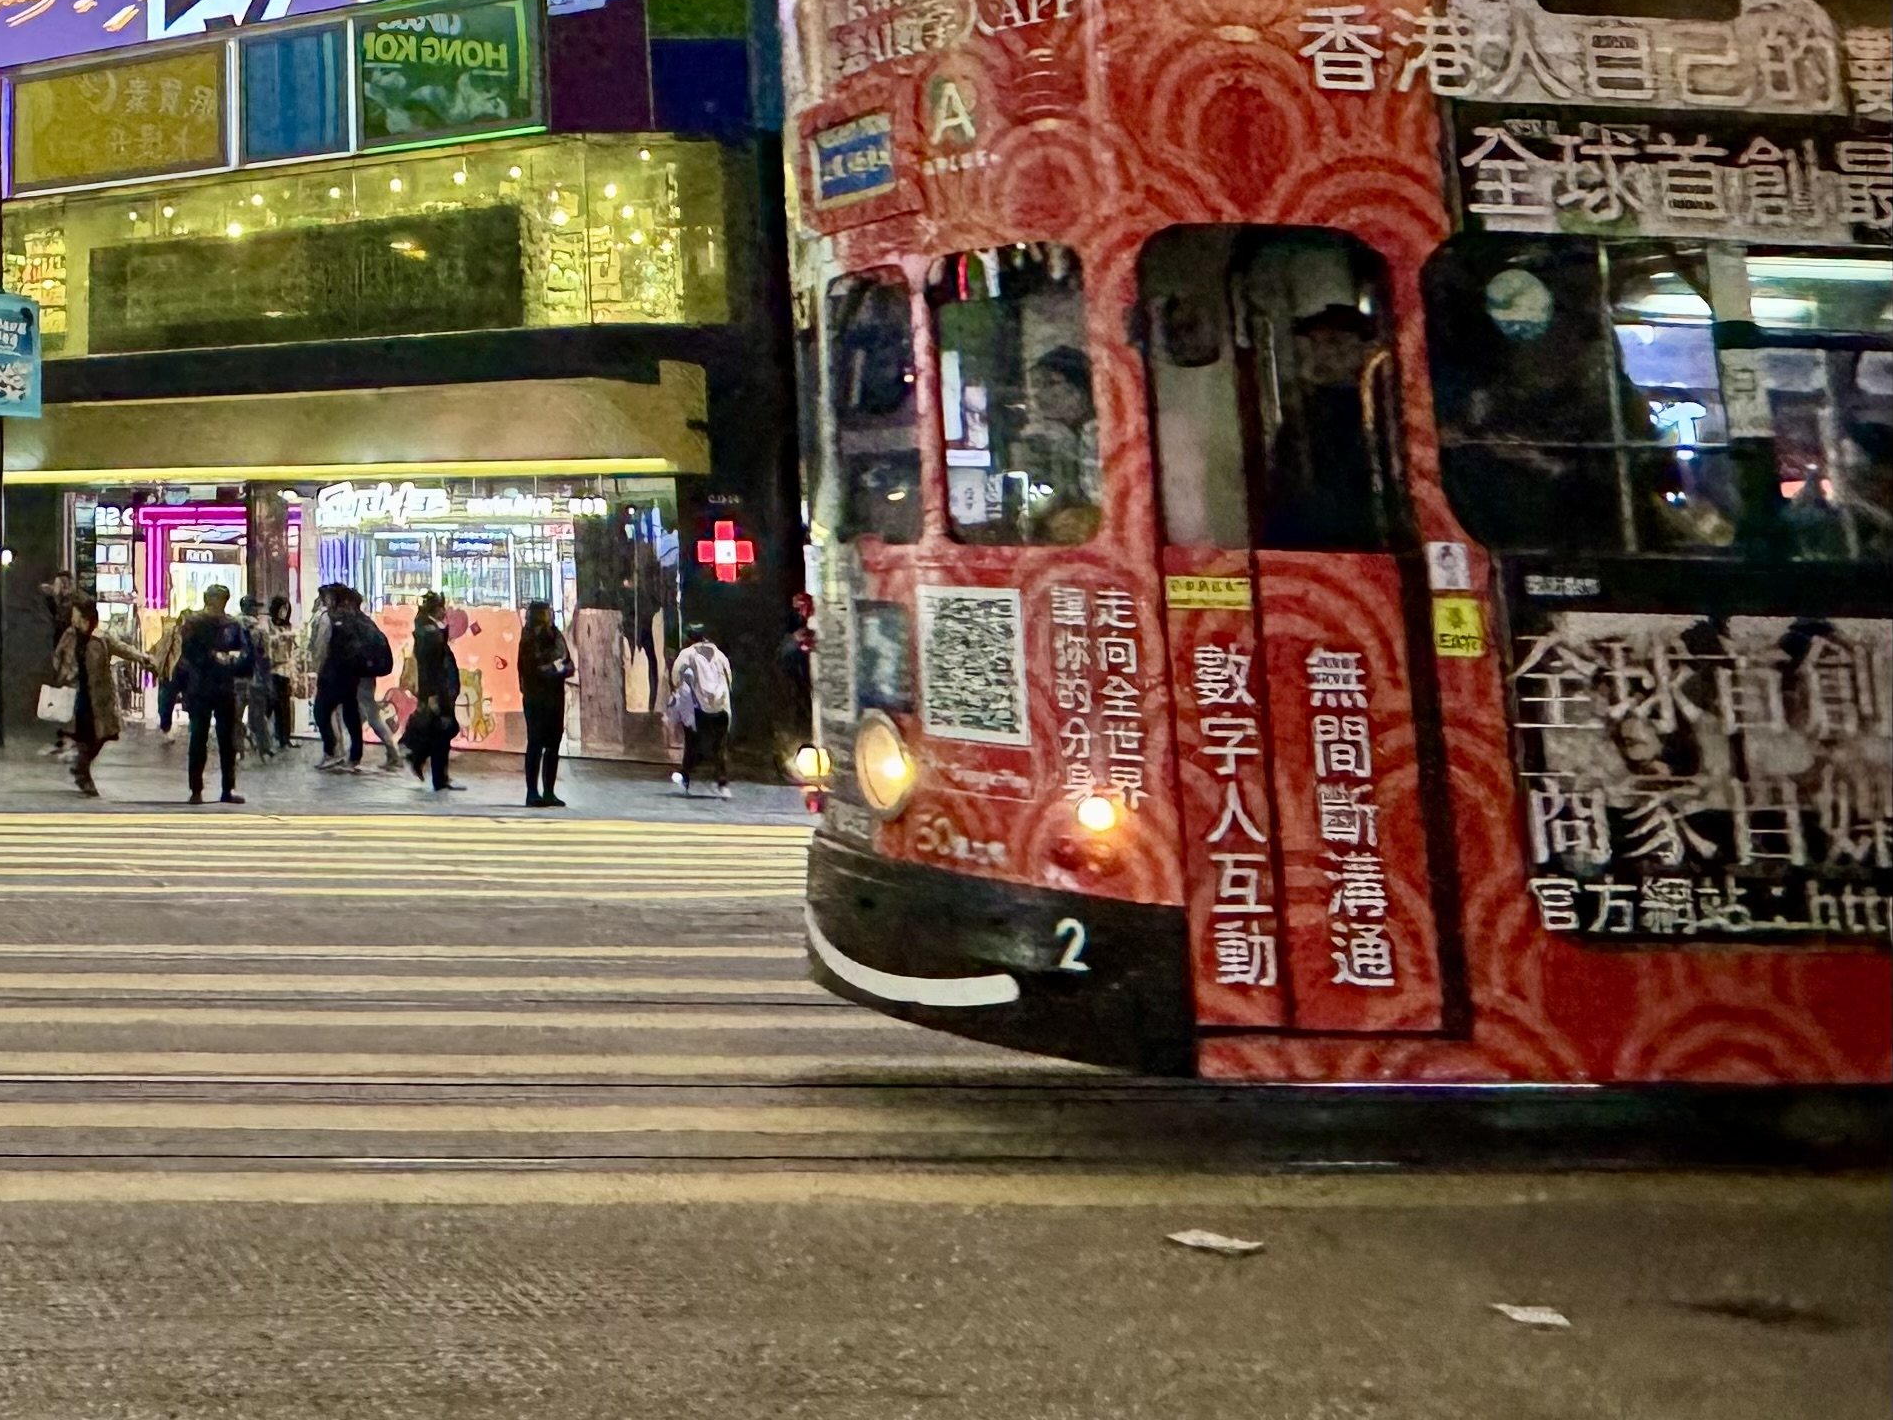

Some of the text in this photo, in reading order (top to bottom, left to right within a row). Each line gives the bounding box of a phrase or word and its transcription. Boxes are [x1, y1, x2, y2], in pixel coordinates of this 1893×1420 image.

[1055, 916, 1090, 970] 2
[1192, 644, 1277, 987] 數字人互動
[1304, 647, 1396, 988] 無間斷溝通
